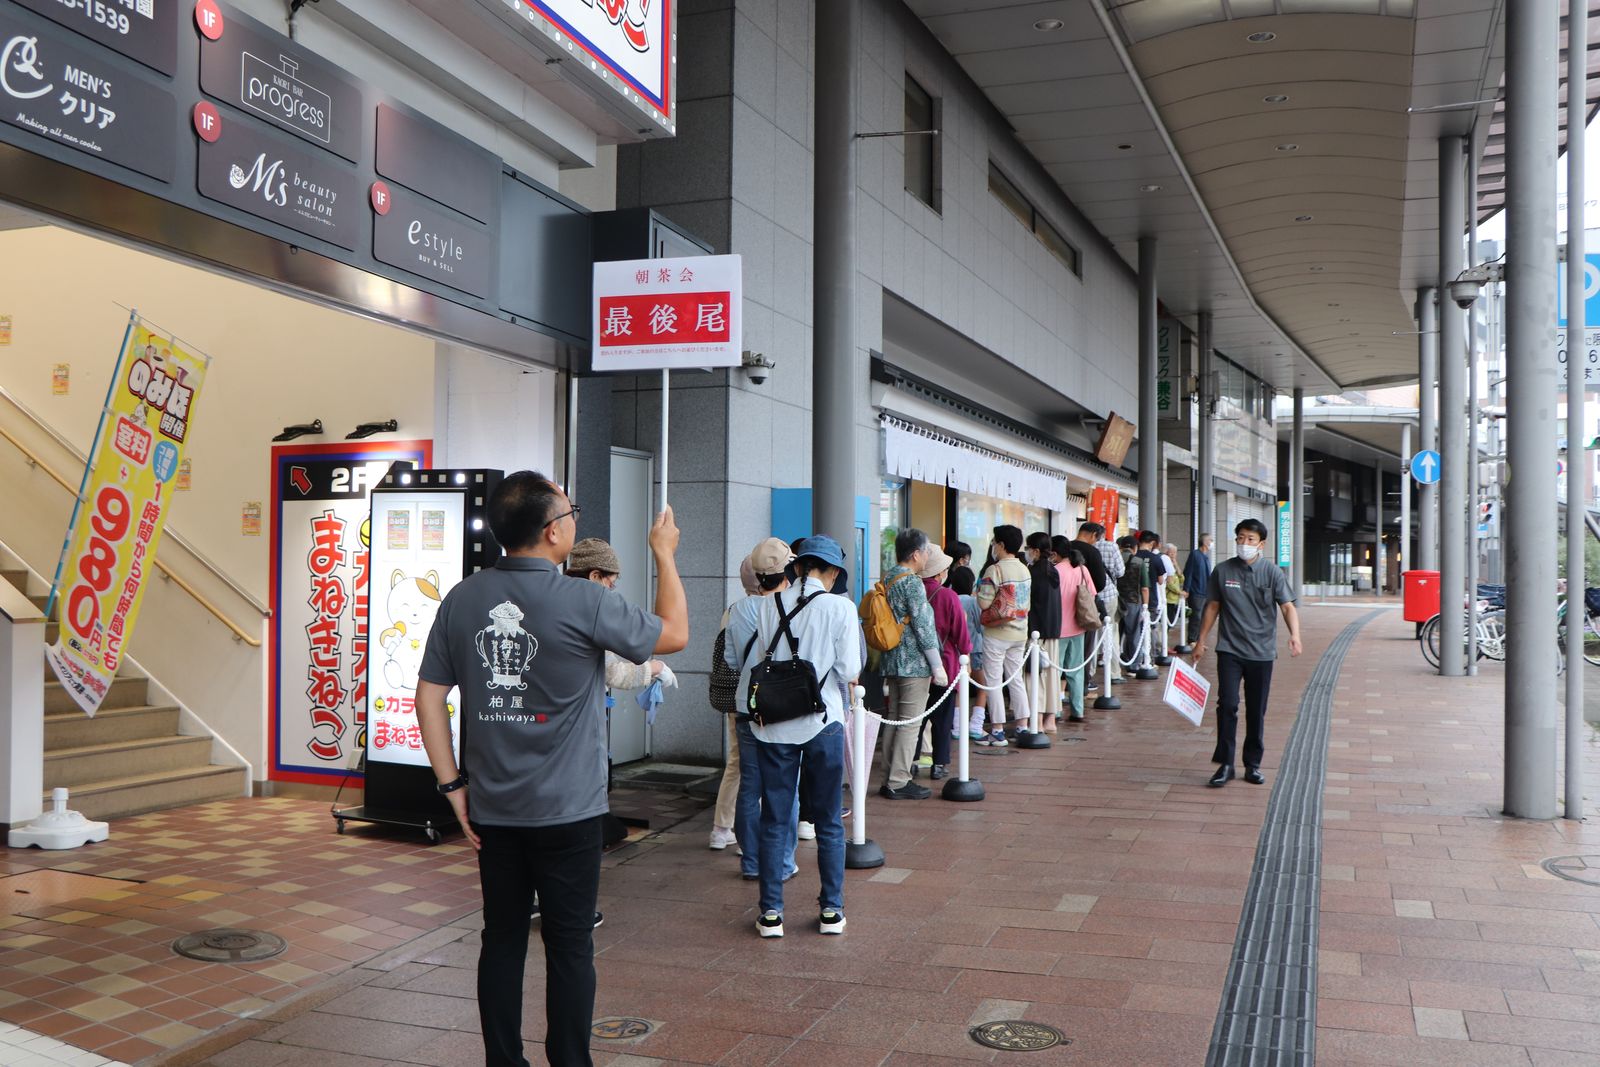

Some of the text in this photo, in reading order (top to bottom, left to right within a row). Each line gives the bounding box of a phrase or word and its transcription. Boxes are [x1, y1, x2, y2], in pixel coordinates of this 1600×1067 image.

[57, 0, 129, 35] -1539
[203, 9, 216, 28] 1F
[64, 64, 112, 99] MEN'S
[292, 84, 304, 98] BAR
[59, 91, 117, 130] クリア
[249, 77, 324, 128] progress
[16, 112, 48, 134] Making
[49, 127, 63, 138] all
[62, 133, 79, 143] men
[202, 112, 215, 131] 1F
[230, 153, 289, 207] M's
[293, 172, 337, 204] beauty
[297, 195, 333, 217] salon
[377, 191, 386, 206] 1F
[424, 233, 463, 261] style
[418, 254, 431, 264] BUY
[440, 262, 454, 273] SELL
[635, 267, 694, 285] 朝茶会
[604, 302, 726, 337] 最後尾
[160, 412, 186, 441] 開催
[117, 422, 149, 461] 室料
[331, 466, 368, 493] 2F
[305, 509, 349, 761] まねきねこ
[488, 695, 525, 709] 柏屋
[478, 711, 536, 725] kashiwaya
